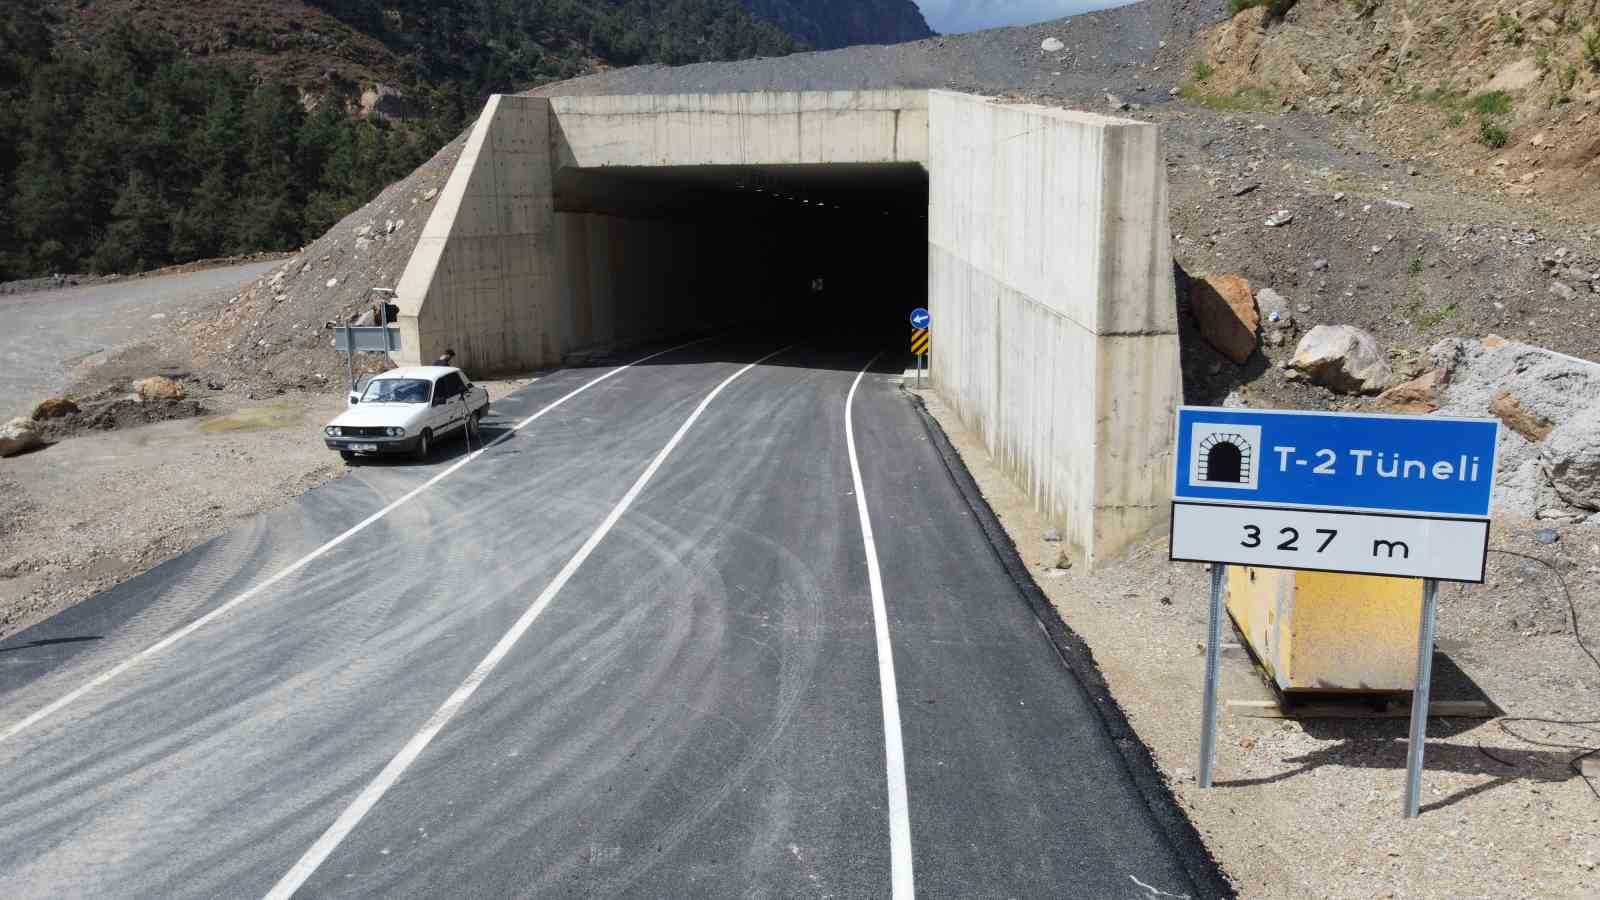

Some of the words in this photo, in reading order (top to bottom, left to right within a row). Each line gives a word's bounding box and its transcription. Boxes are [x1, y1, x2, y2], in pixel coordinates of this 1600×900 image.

[1273, 446, 1337, 475] T-2
[1350, 449, 1480, 482] Tüneli
[1240, 525, 1338, 553] 327
[1373, 539, 1409, 559] m
